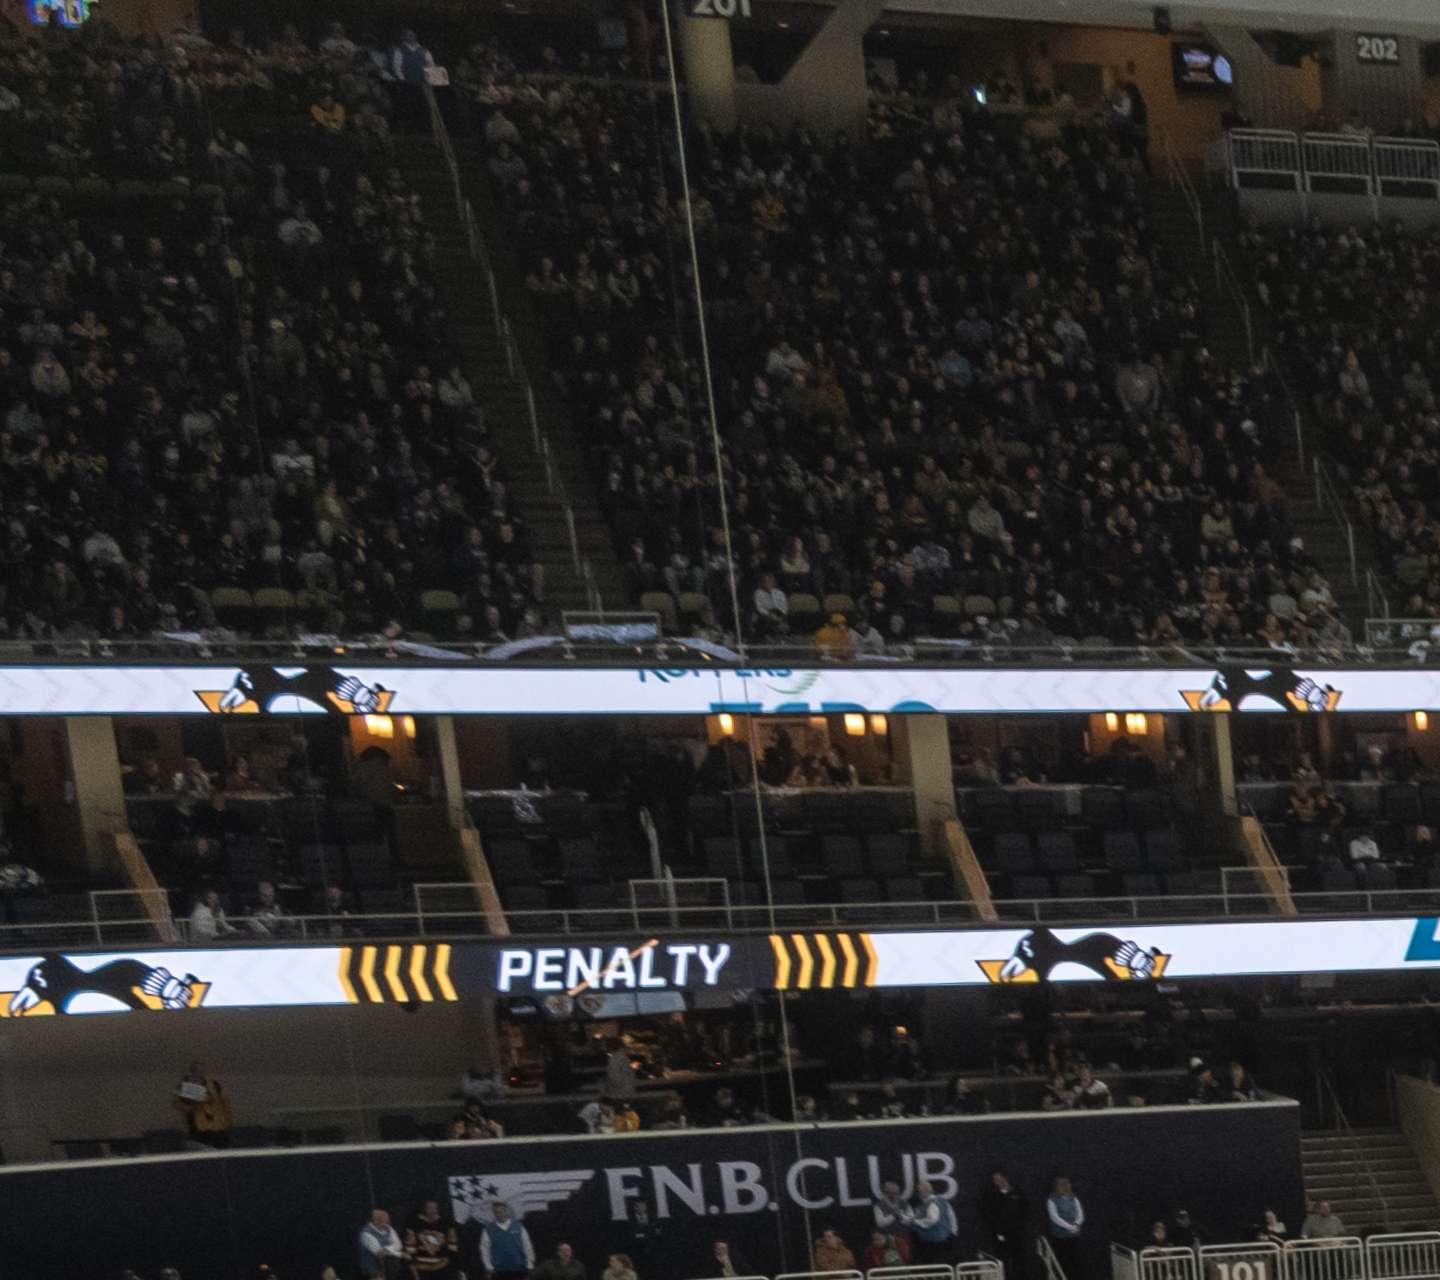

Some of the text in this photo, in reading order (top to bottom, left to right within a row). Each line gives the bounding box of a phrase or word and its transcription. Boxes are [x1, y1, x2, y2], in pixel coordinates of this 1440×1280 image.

[1357, 35, 1398, 61] 202
[497, 944, 731, 992] PENALTY
[604, 1151, 960, 1222] F.N.B. CLUB
